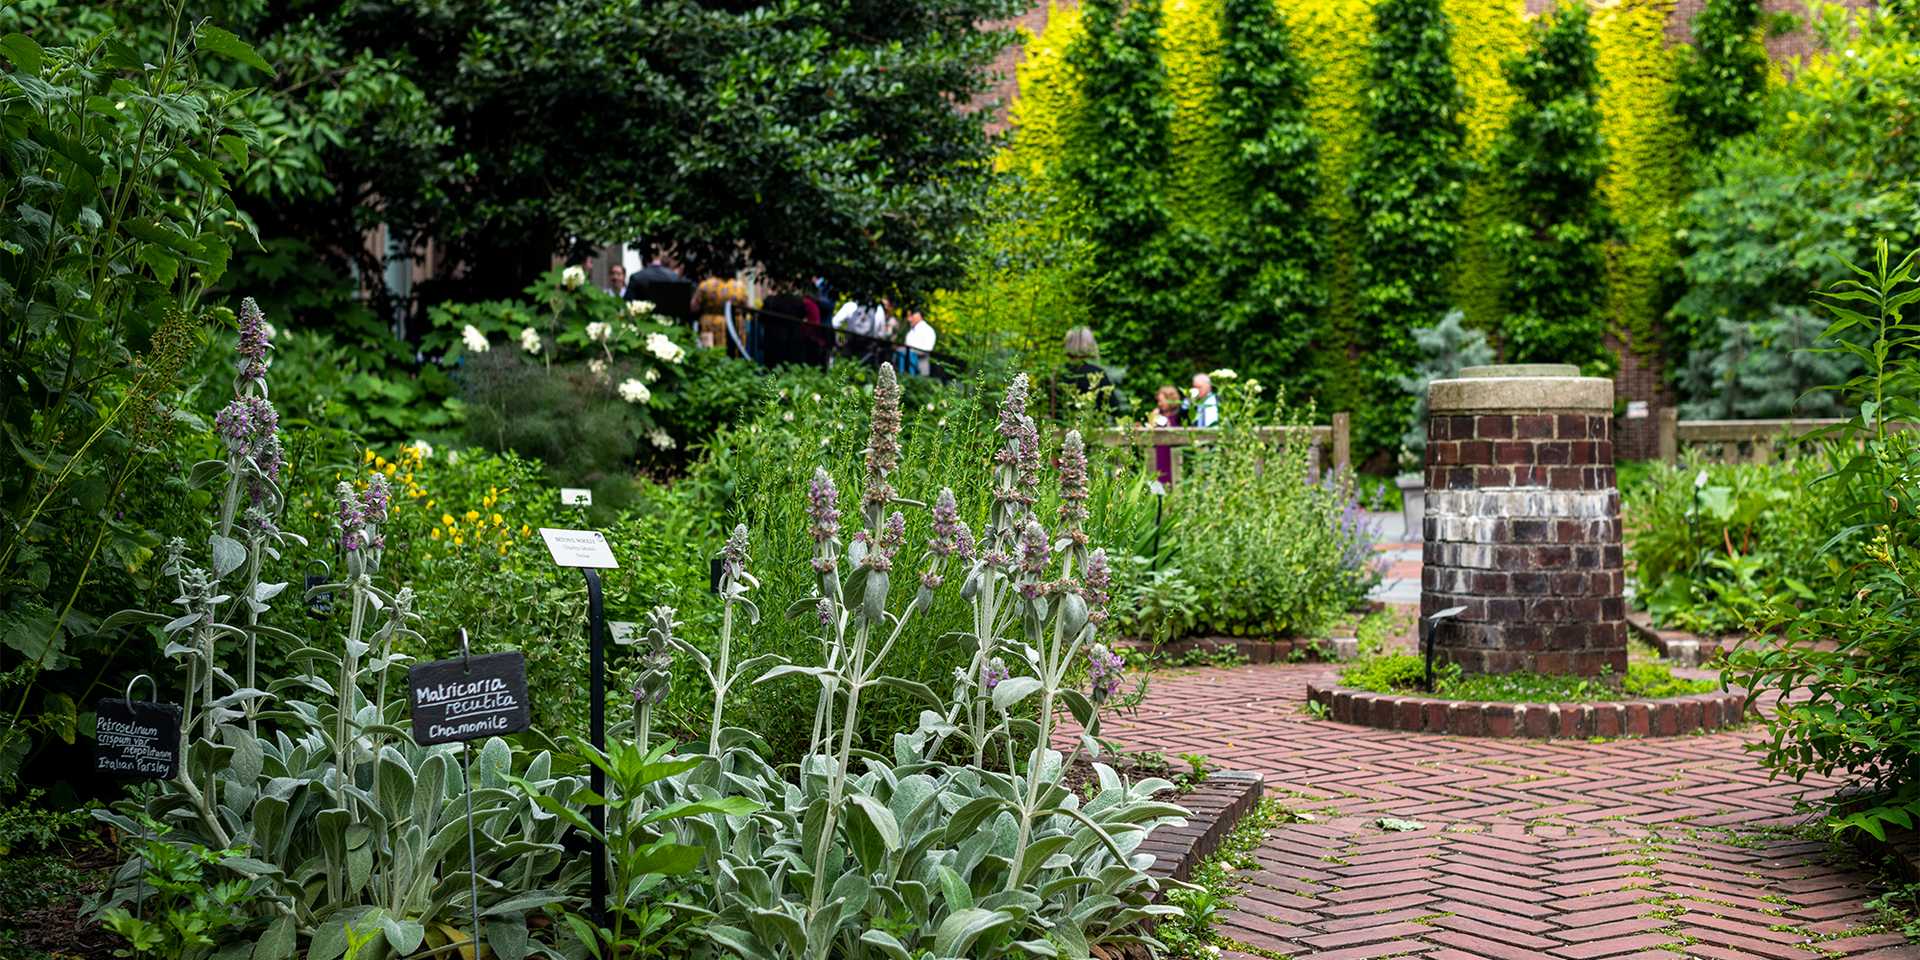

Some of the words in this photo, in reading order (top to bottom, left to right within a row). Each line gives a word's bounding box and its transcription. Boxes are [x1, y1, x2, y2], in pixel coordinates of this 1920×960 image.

[416, 678, 506, 704] Matricaria
[445, 691, 517, 715] recutita
[96, 716, 158, 736] Petroselinum
[429, 714, 508, 738] Chamomile
[98, 734, 131, 748] crispum
[98, 756, 135, 770] Italian
[136, 758, 169, 778] Parsley
